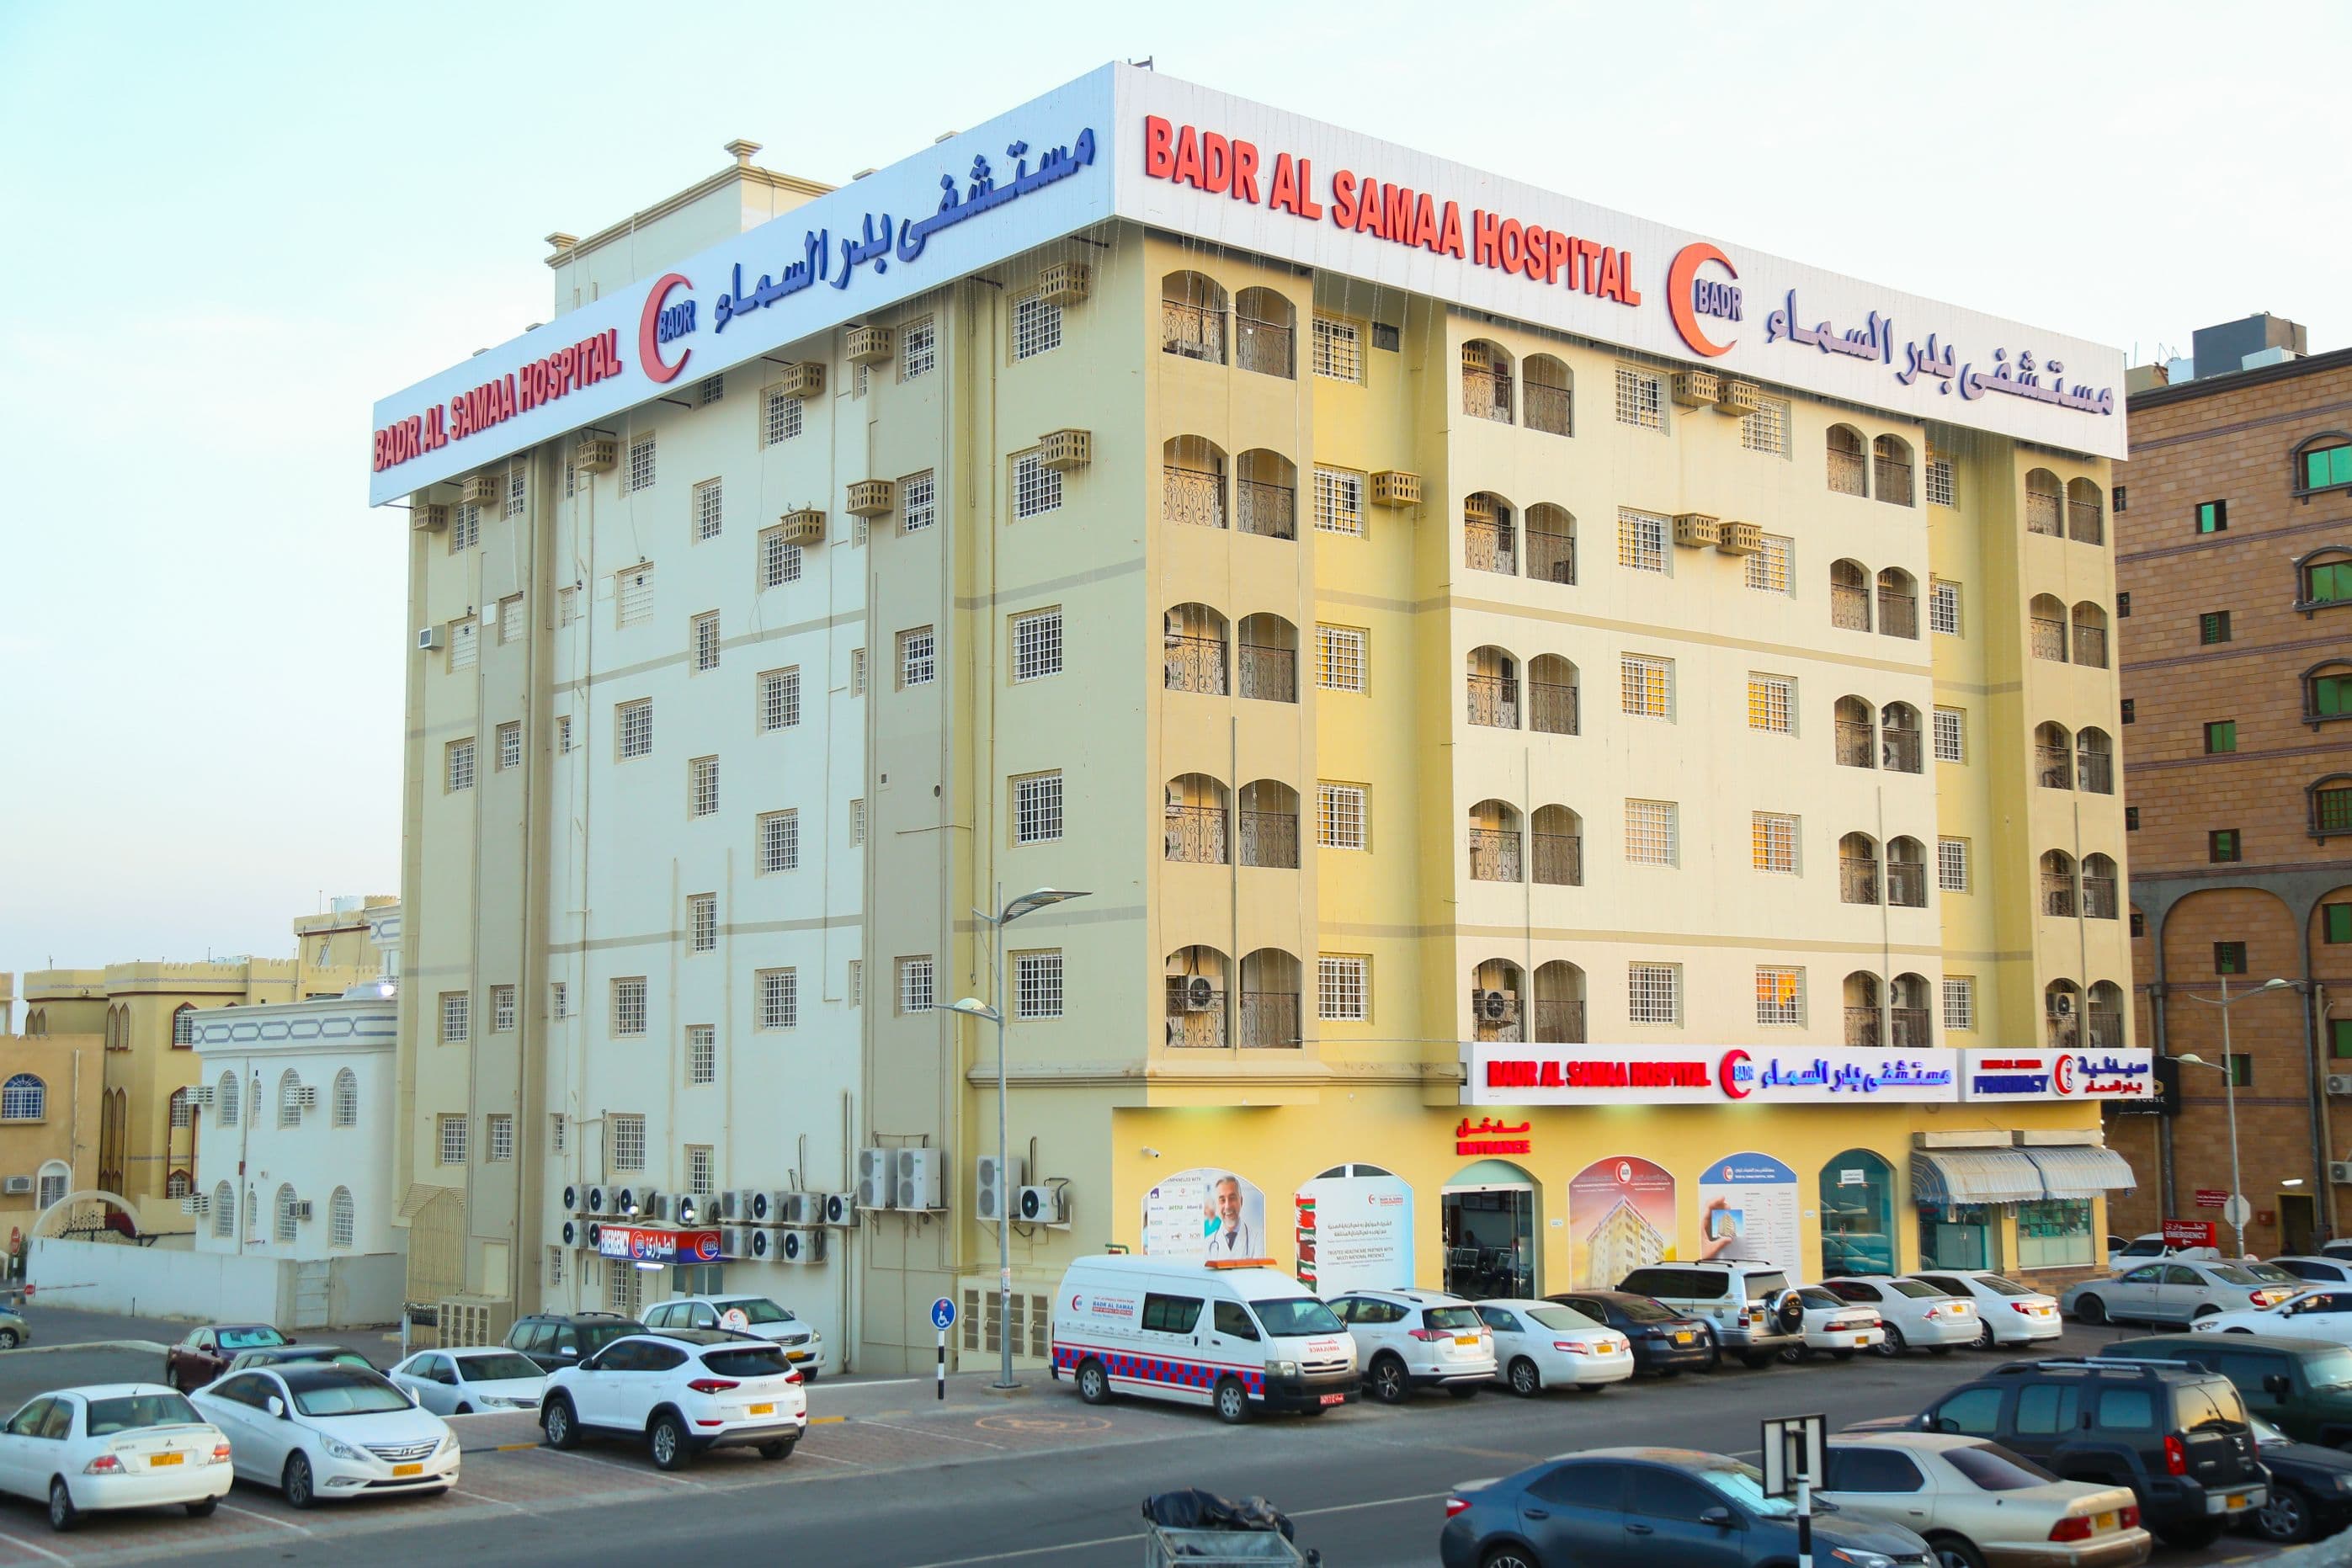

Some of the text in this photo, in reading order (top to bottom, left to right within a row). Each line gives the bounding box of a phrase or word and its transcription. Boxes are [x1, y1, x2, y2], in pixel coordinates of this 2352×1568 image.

[1145, 114, 1642, 306] BADR AL SAMAA HOSPITAL
[714, 127, 1095, 333] مستشفى بدر السماء
[1695, 278, 1743, 322] BADR
[657, 300, 696, 343] BADR
[1767, 289, 2114, 415] مستشفى بدر السماء
[374, 328, 622, 472] BADR AL SAMAA HOSPITAL
[1487, 1061, 1538, 1087] BADR
[1540, 1061, 1565, 1087] AL
[1630, 1062, 1711, 1087] HOSPITAL
[1732, 1065, 1754, 1081] BADR
[1762, 1058, 1952, 1092] مستشفى بدر السماء
[1456, 1117, 1530, 1138] مدخل
[1456, 1140, 1530, 1155] ENTRANCE
[601, 1230, 630, 1257] EMERGENCY
[703, 1241, 718, 1252] BADR
[2166, 1231, 2207, 1240] EMERGENCY
